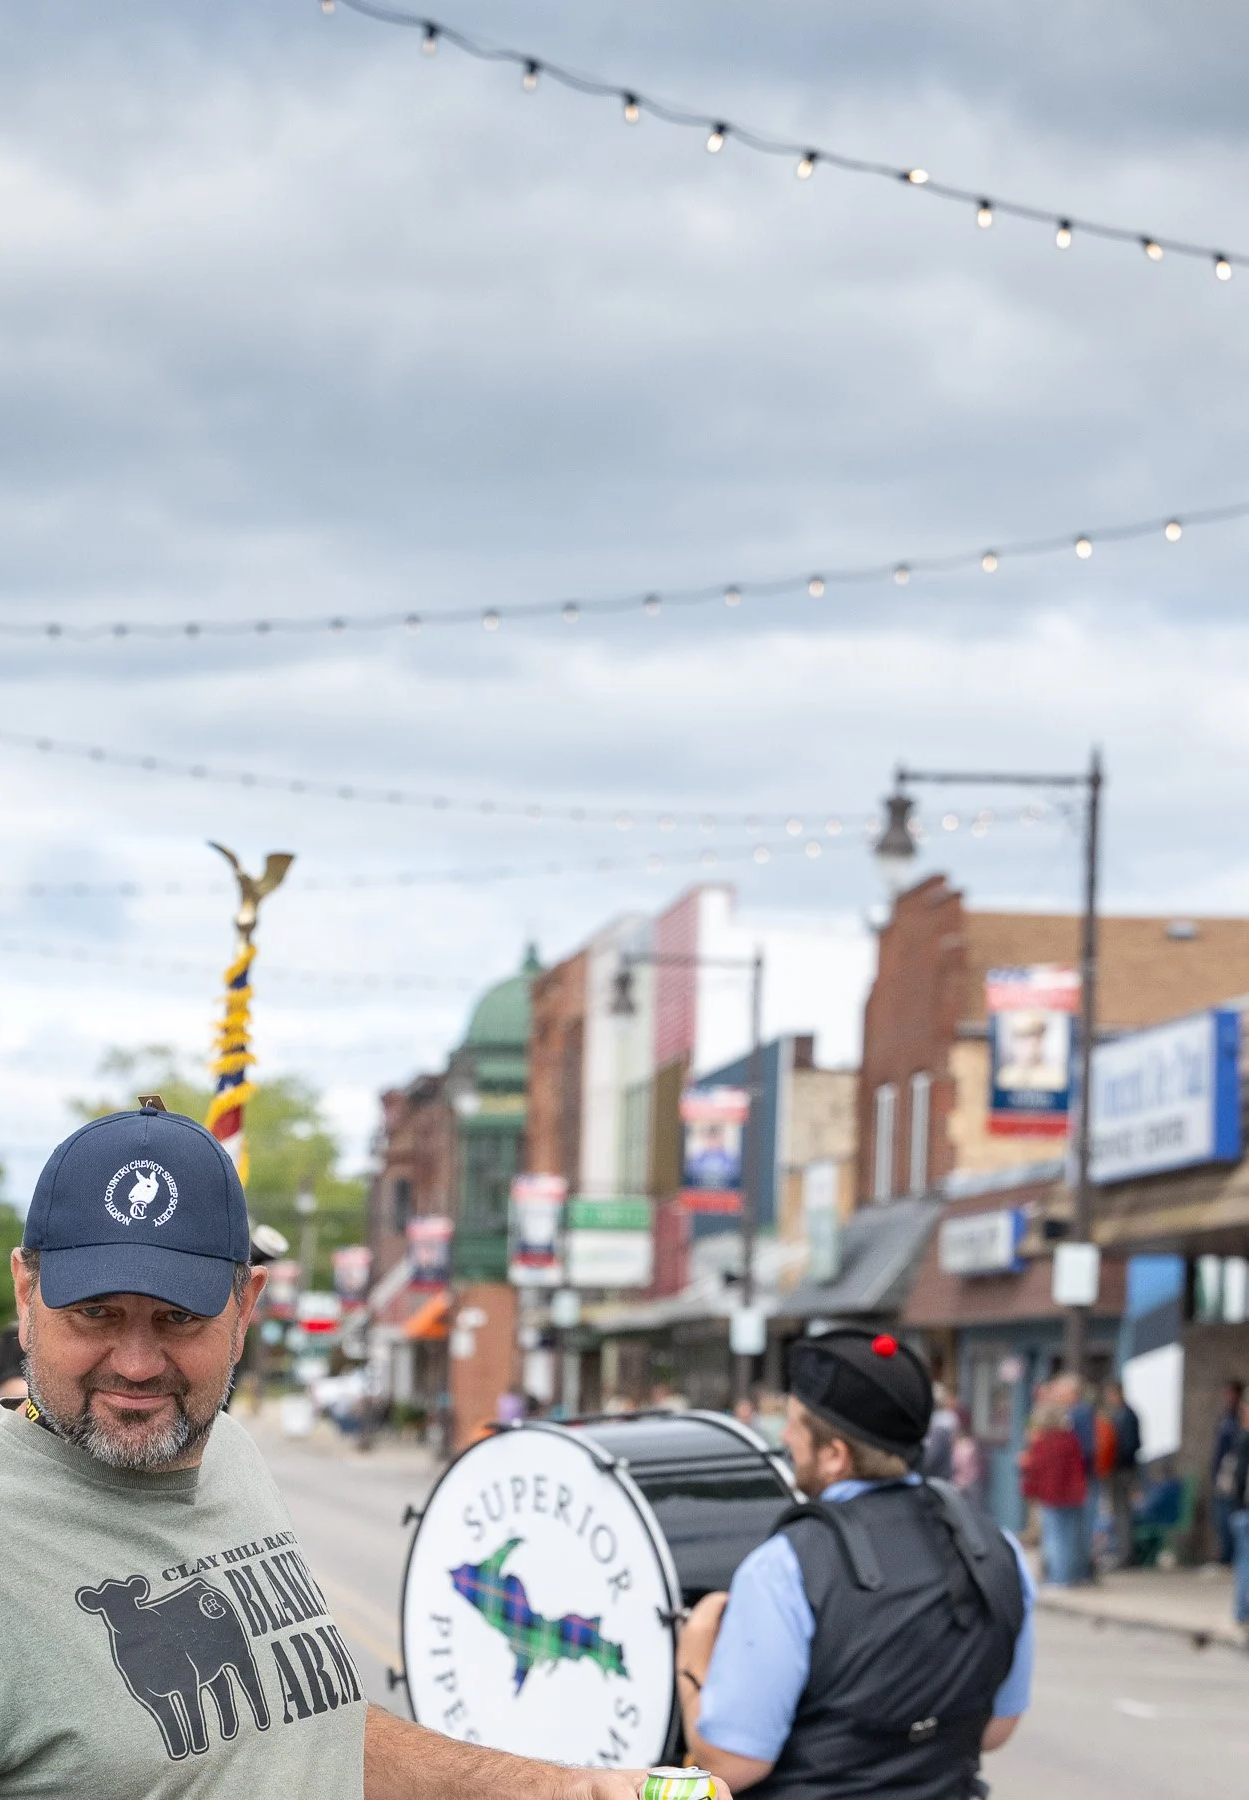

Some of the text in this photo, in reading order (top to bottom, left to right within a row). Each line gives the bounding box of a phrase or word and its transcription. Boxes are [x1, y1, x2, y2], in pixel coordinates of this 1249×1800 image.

[104, 1160, 178, 1227] NORTH COUNTRY CHEVIOT SHEEP SOCIETY
[161, 1531, 298, 1582] CLAY HILL RAN
[462, 1474, 633, 1604] SUPERIOR
